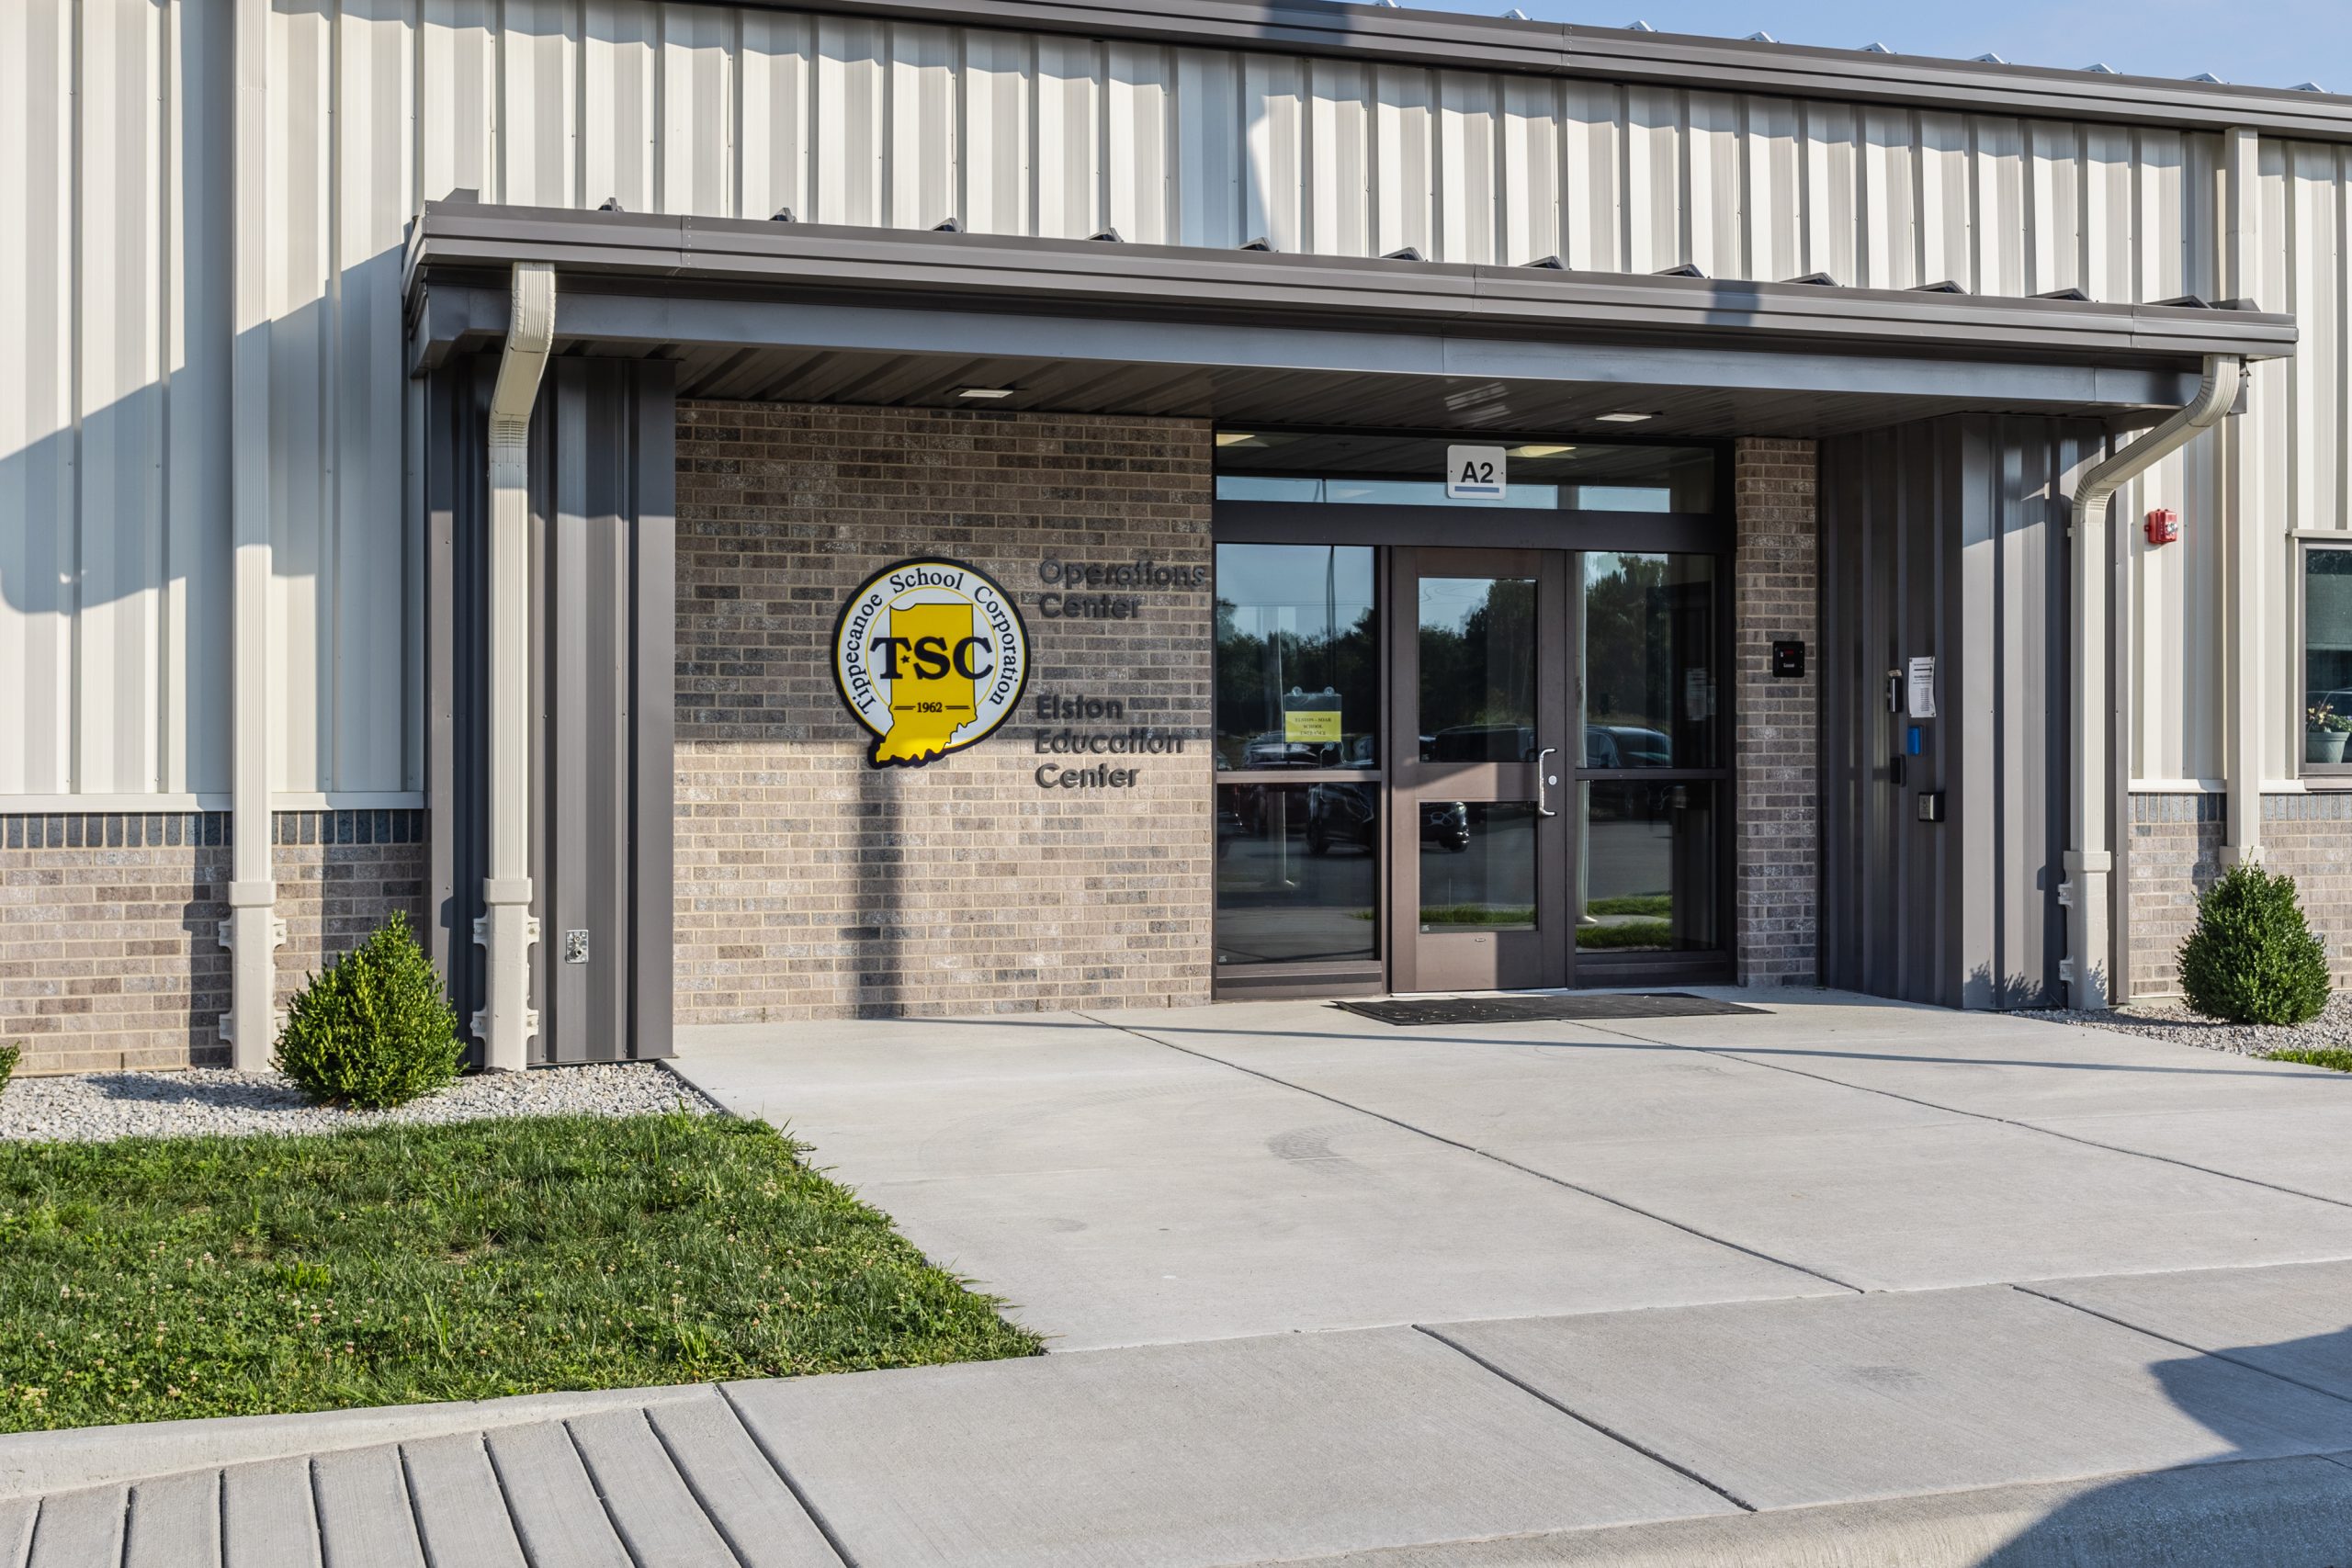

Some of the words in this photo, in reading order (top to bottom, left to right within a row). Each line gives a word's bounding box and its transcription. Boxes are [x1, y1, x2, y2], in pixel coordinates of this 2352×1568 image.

[1461, 461, 1493, 483] A2
[1040, 559, 1205, 590] Operations
[1040, 593, 1141, 618] Center
[846, 594, 882, 715] Tippecanoe
[889, 568, 964, 593] School
[975, 586, 1018, 705] Corporation
[870, 637, 993, 680] TSC
[917, 703, 942, 713] 1962
[1037, 694, 1123, 719] Elston
[1035, 728, 1184, 754] Education
[1035, 763, 1140, 788] Center
